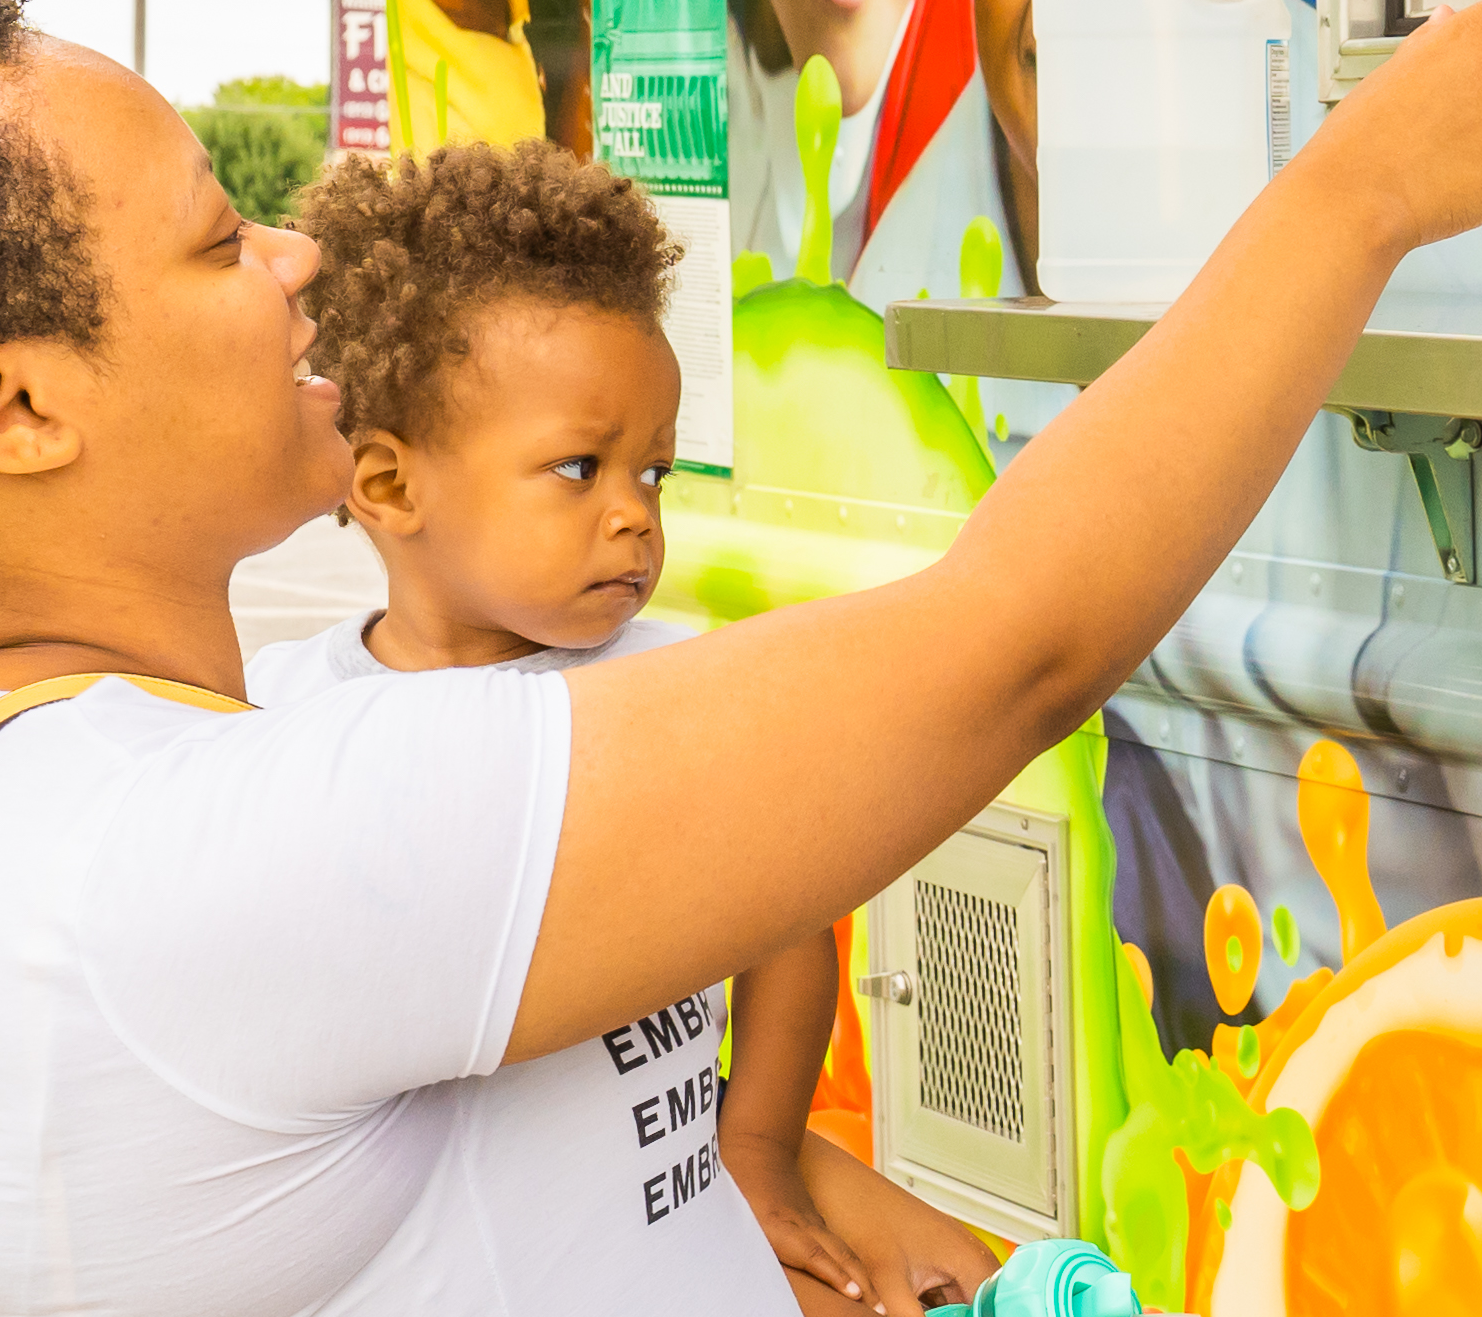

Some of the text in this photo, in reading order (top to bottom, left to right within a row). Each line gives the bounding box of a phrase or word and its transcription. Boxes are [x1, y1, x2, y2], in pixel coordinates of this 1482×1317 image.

[600, 72, 632, 99] AND
[599, 102, 662, 129] JUSTICE
[614, 131, 645, 157] ALL
[643, 1133, 721, 1225] EMBR
